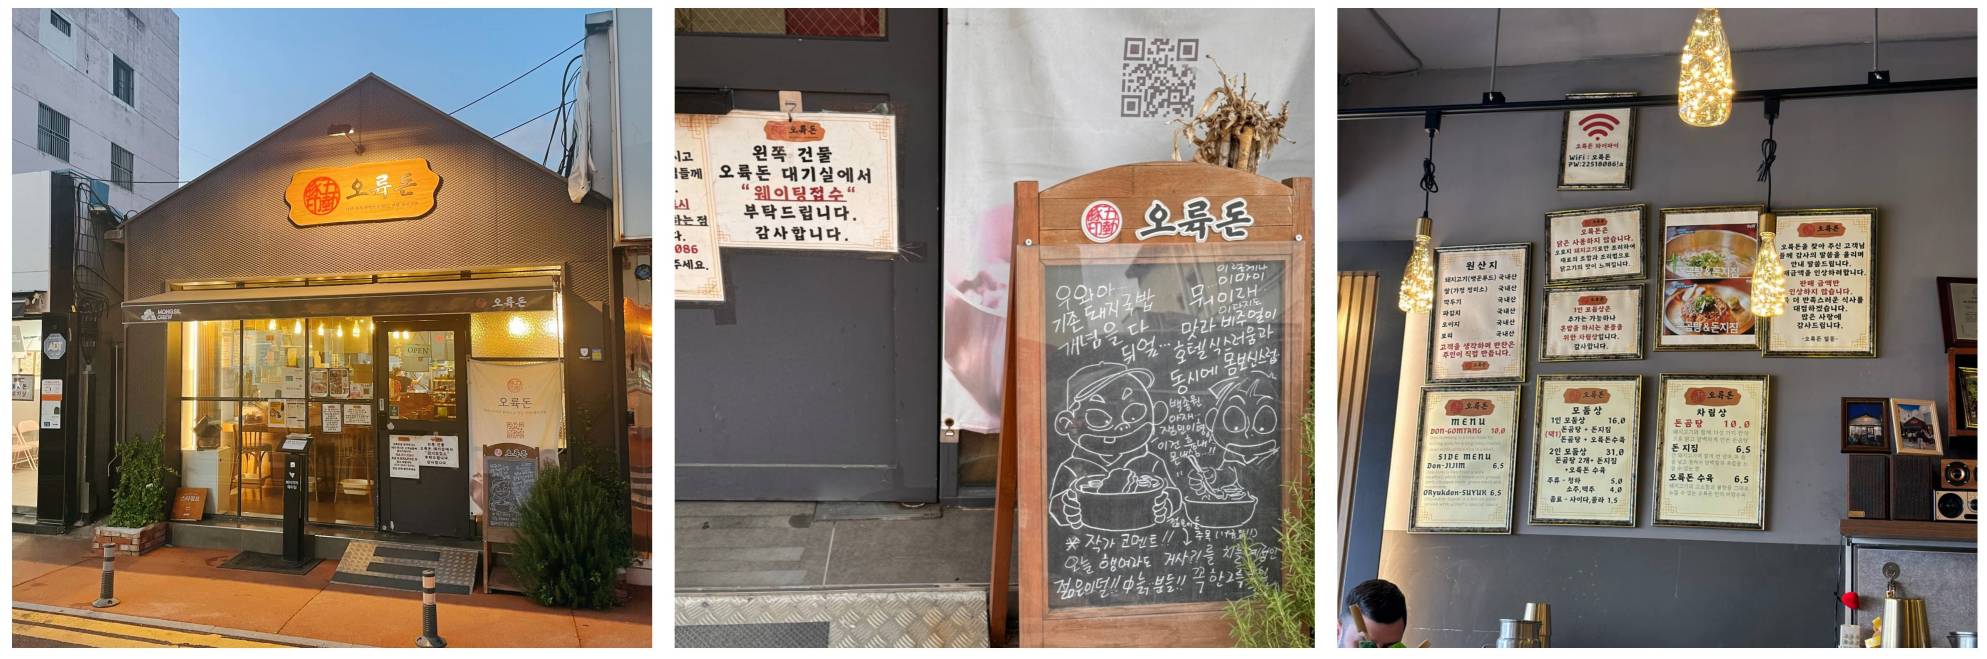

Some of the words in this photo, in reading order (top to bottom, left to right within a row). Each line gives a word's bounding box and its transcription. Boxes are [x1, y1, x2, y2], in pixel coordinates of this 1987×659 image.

[789, 124, 816, 135] 오륙돈
[753, 145, 787, 162] 왼쪽
[798, 146, 832, 163] 건물
[719, 164, 771, 181] 오륙돈
[782, 166, 871, 183] 대기실에서
[744, 204, 857, 221] 부탁드립니다.
[1138, 199, 1253, 240] 오륙돈
[755, 226, 848, 242] 감사합니다.
[1466, 260, 1498, 270] 원산지
[492, 296, 527, 308] 오륙돈
[1052, 311, 1084, 333] 기존
[1084, 288, 1156, 320] 돼지국밥
[1128, 320, 1149, 335] 다
[407, 346, 429, 354] OPEN
[1574, 342, 1609, 350] 감사합니다.
[1171, 365, 1218, 395] 동시에
[498, 397, 533, 409] 오륙돈
[1572, 406, 1602, 415] 모둠상
[1697, 408, 1727, 417] 차림상
[1608, 417, 1626, 425] 16.0
[1674, 419, 1703, 428] 돈곰탕
[1724, 420, 1750, 428] 10.0
[1493, 462, 1504, 470] 6.5
[1669, 473, 1694, 482] 오륙돈
[1697, 473, 1714, 482] 수육
[1734, 475, 1749, 483] 6.5
[1490, 489, 1502, 497] 6.5
